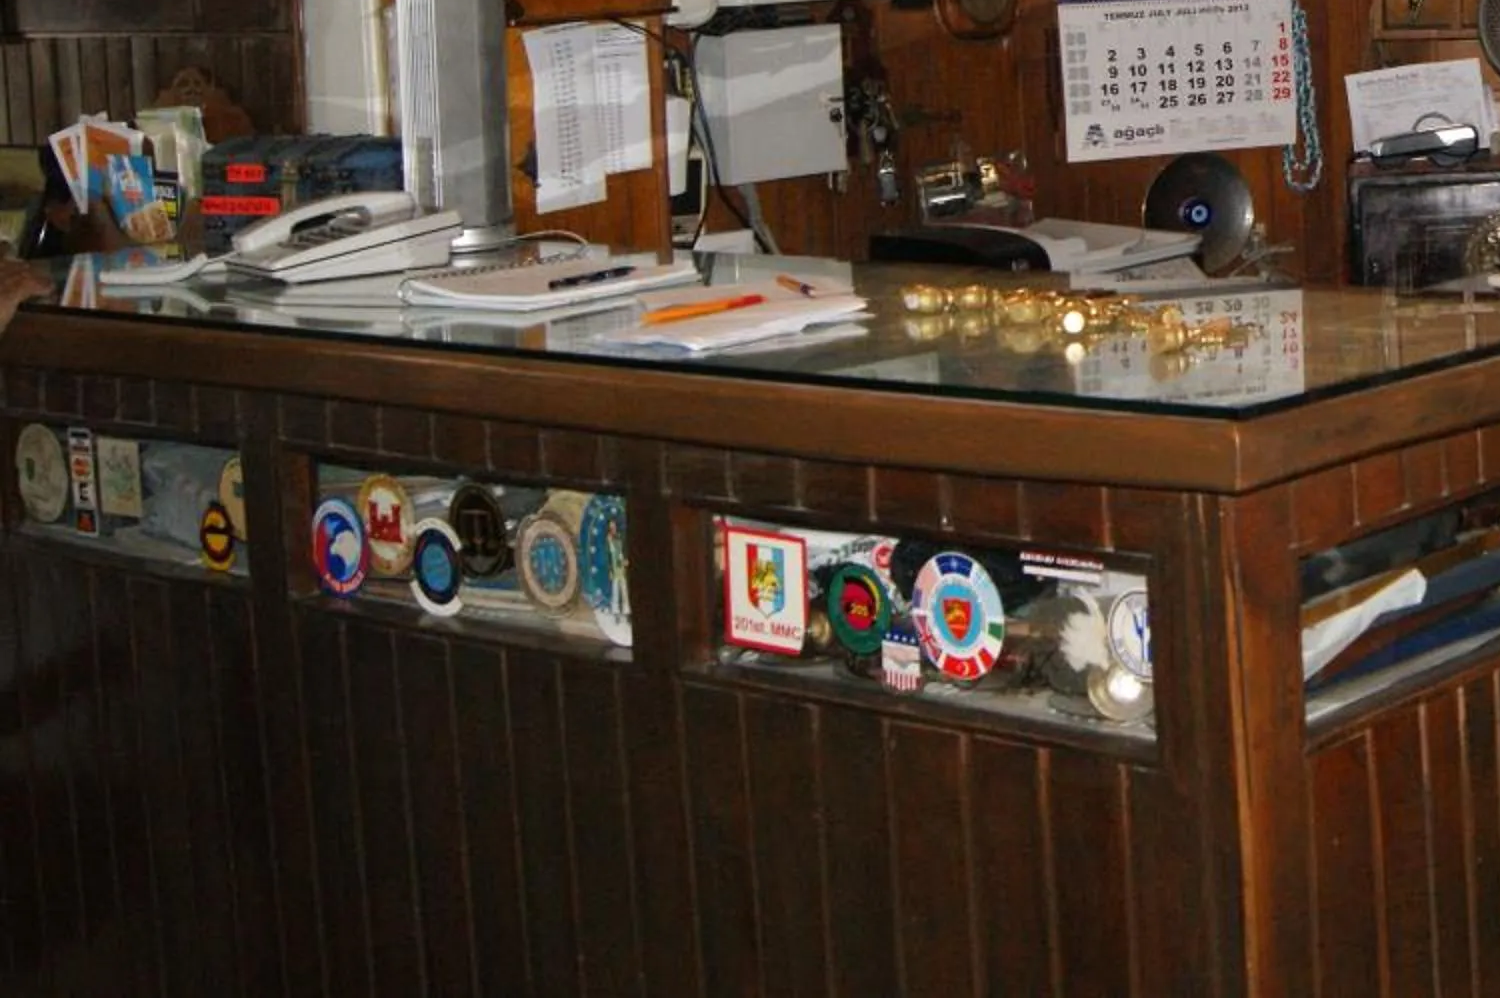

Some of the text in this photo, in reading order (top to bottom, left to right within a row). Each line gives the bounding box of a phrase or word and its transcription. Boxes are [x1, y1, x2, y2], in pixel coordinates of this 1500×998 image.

[1280, 22, 1284, 33] 1
[1108, 50, 1117, 62] 2
[1137, 48, 1146, 60] 3
[1165, 46, 1175, 57] 4
[1194, 44, 1204, 56] 5
[1223, 42, 1232, 54] 6
[1252, 40, 1260, 51] 7
[1279, 38, 1288, 50] 8
[1108, 66, 1118, 78] 9
[1129, 64, 1147, 76] 10
[1158, 63, 1174, 74] 11
[1187, 60, 1204, 72] 12
[1216, 58, 1233, 70] 13
[1272, 54, 1289, 67] 15
[1101, 84, 1119, 96] 16
[1131, 81, 1147, 94] 17
[1159, 79, 1177, 91] 18
[1188, 77, 1205, 89] 19
[1216, 74, 1234, 87] 20
[1272, 70, 1290, 83] 22
[1160, 96, 1178, 108] 25
[1188, 94, 1206, 106] 26
[1217, 91, 1235, 104] 27
[1273, 87, 1291, 100] 29
